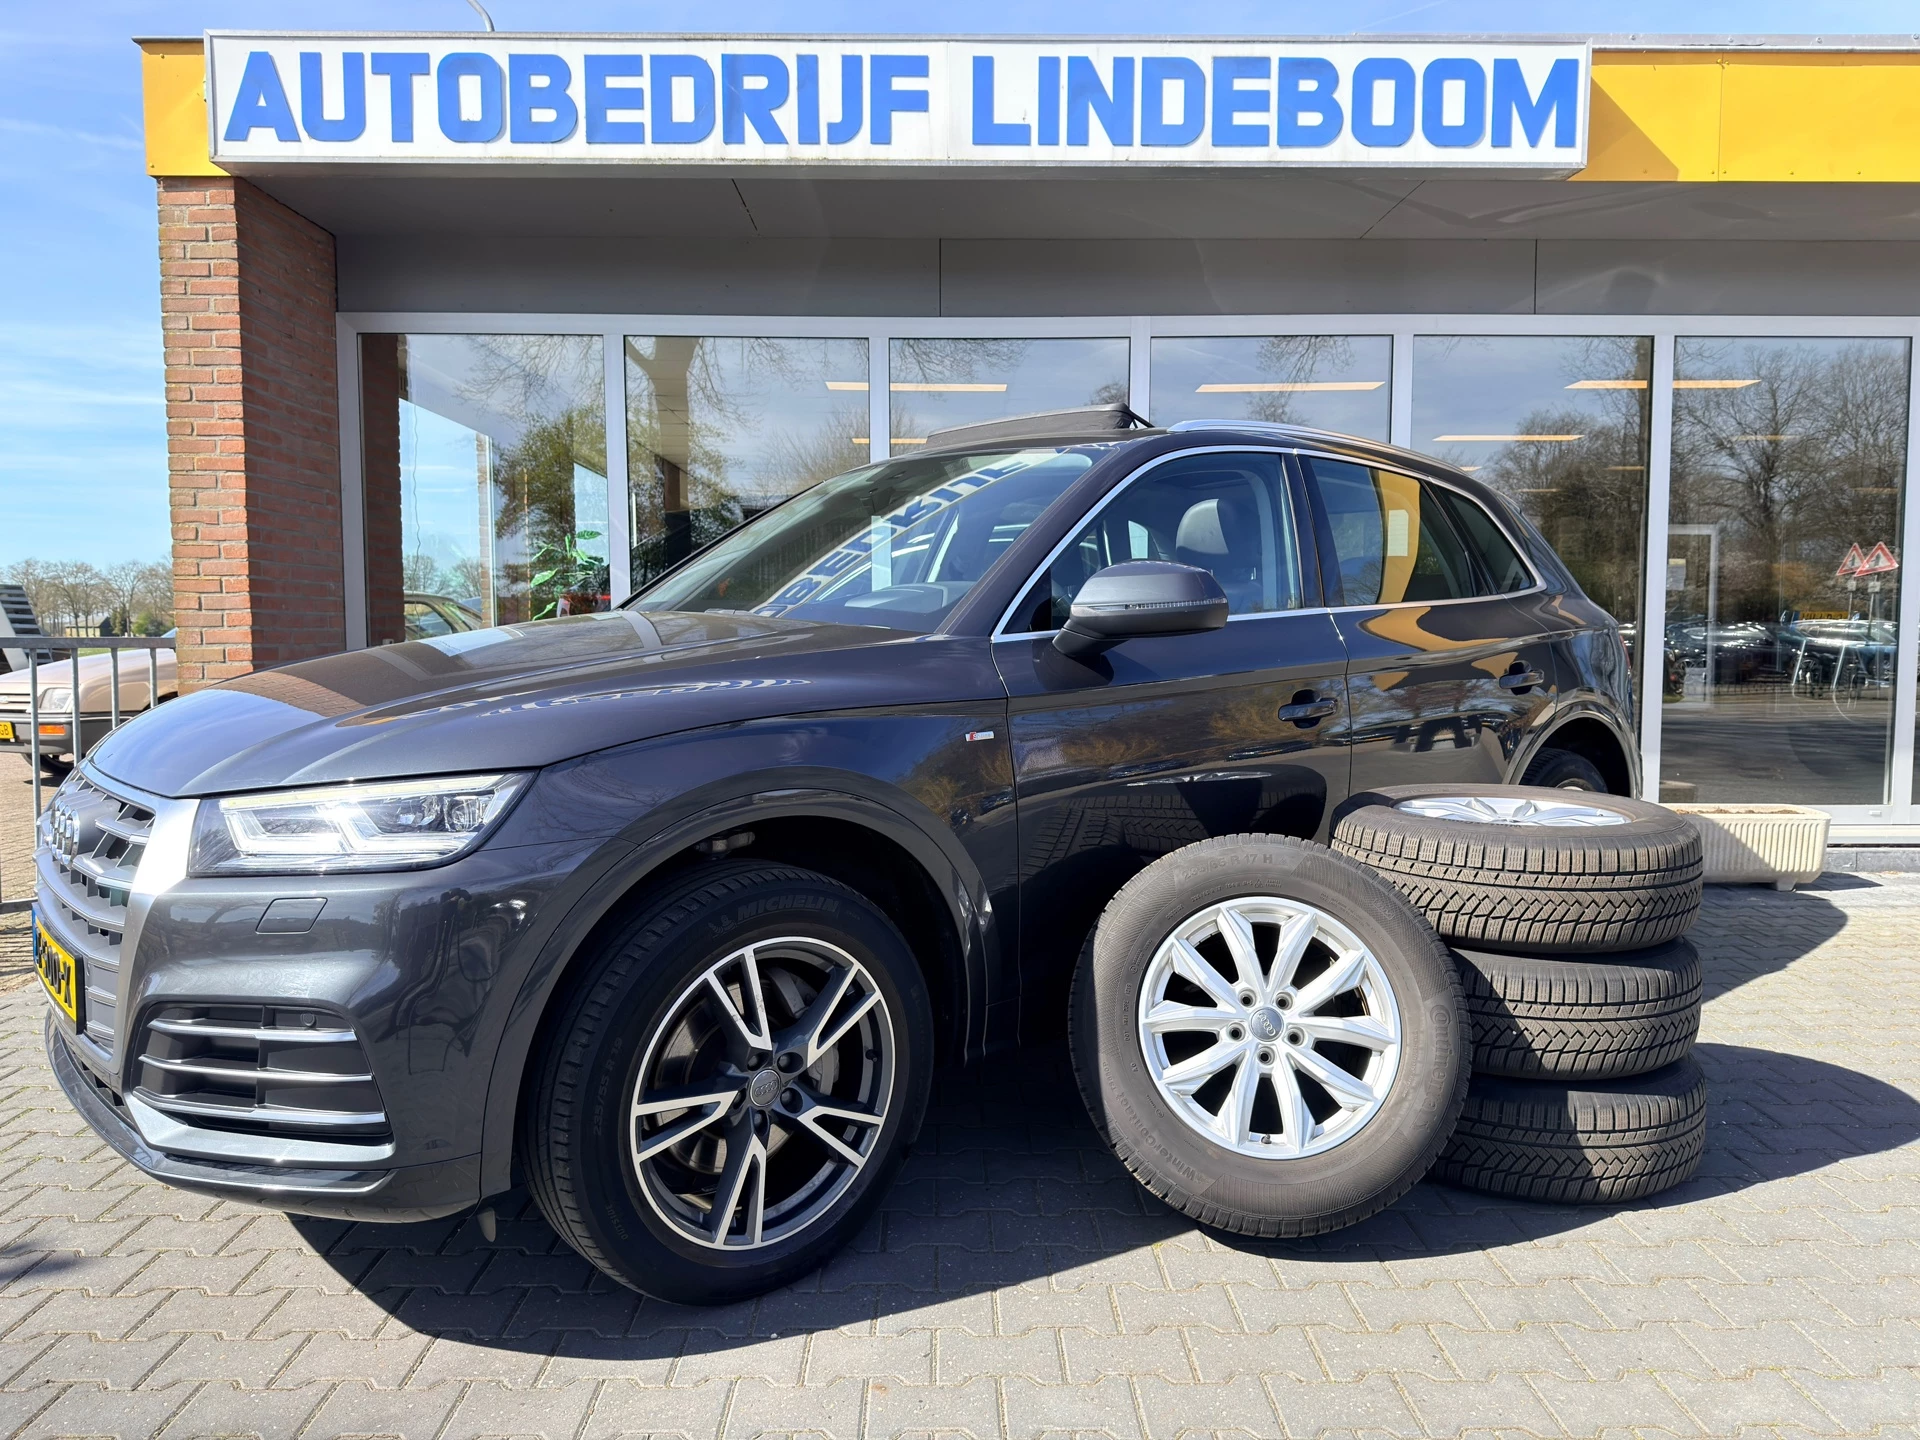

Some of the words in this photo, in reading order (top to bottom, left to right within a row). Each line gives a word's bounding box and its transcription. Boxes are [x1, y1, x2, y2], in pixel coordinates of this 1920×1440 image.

[223, 51, 931, 146] AUTOBEDRIJF
[972, 55, 1580, 148] LINDEBOOM
[1229, 855, 1241, 867] R
[1242, 853, 1258, 865] 17
[1261, 853, 1273, 864] H
[738, 894, 840, 921] MICHELIN
[593, 1075, 610, 1136] 235/55
[605, 1058, 616, 1069] R
[1113, 1090, 1198, 1182] WinterContact
